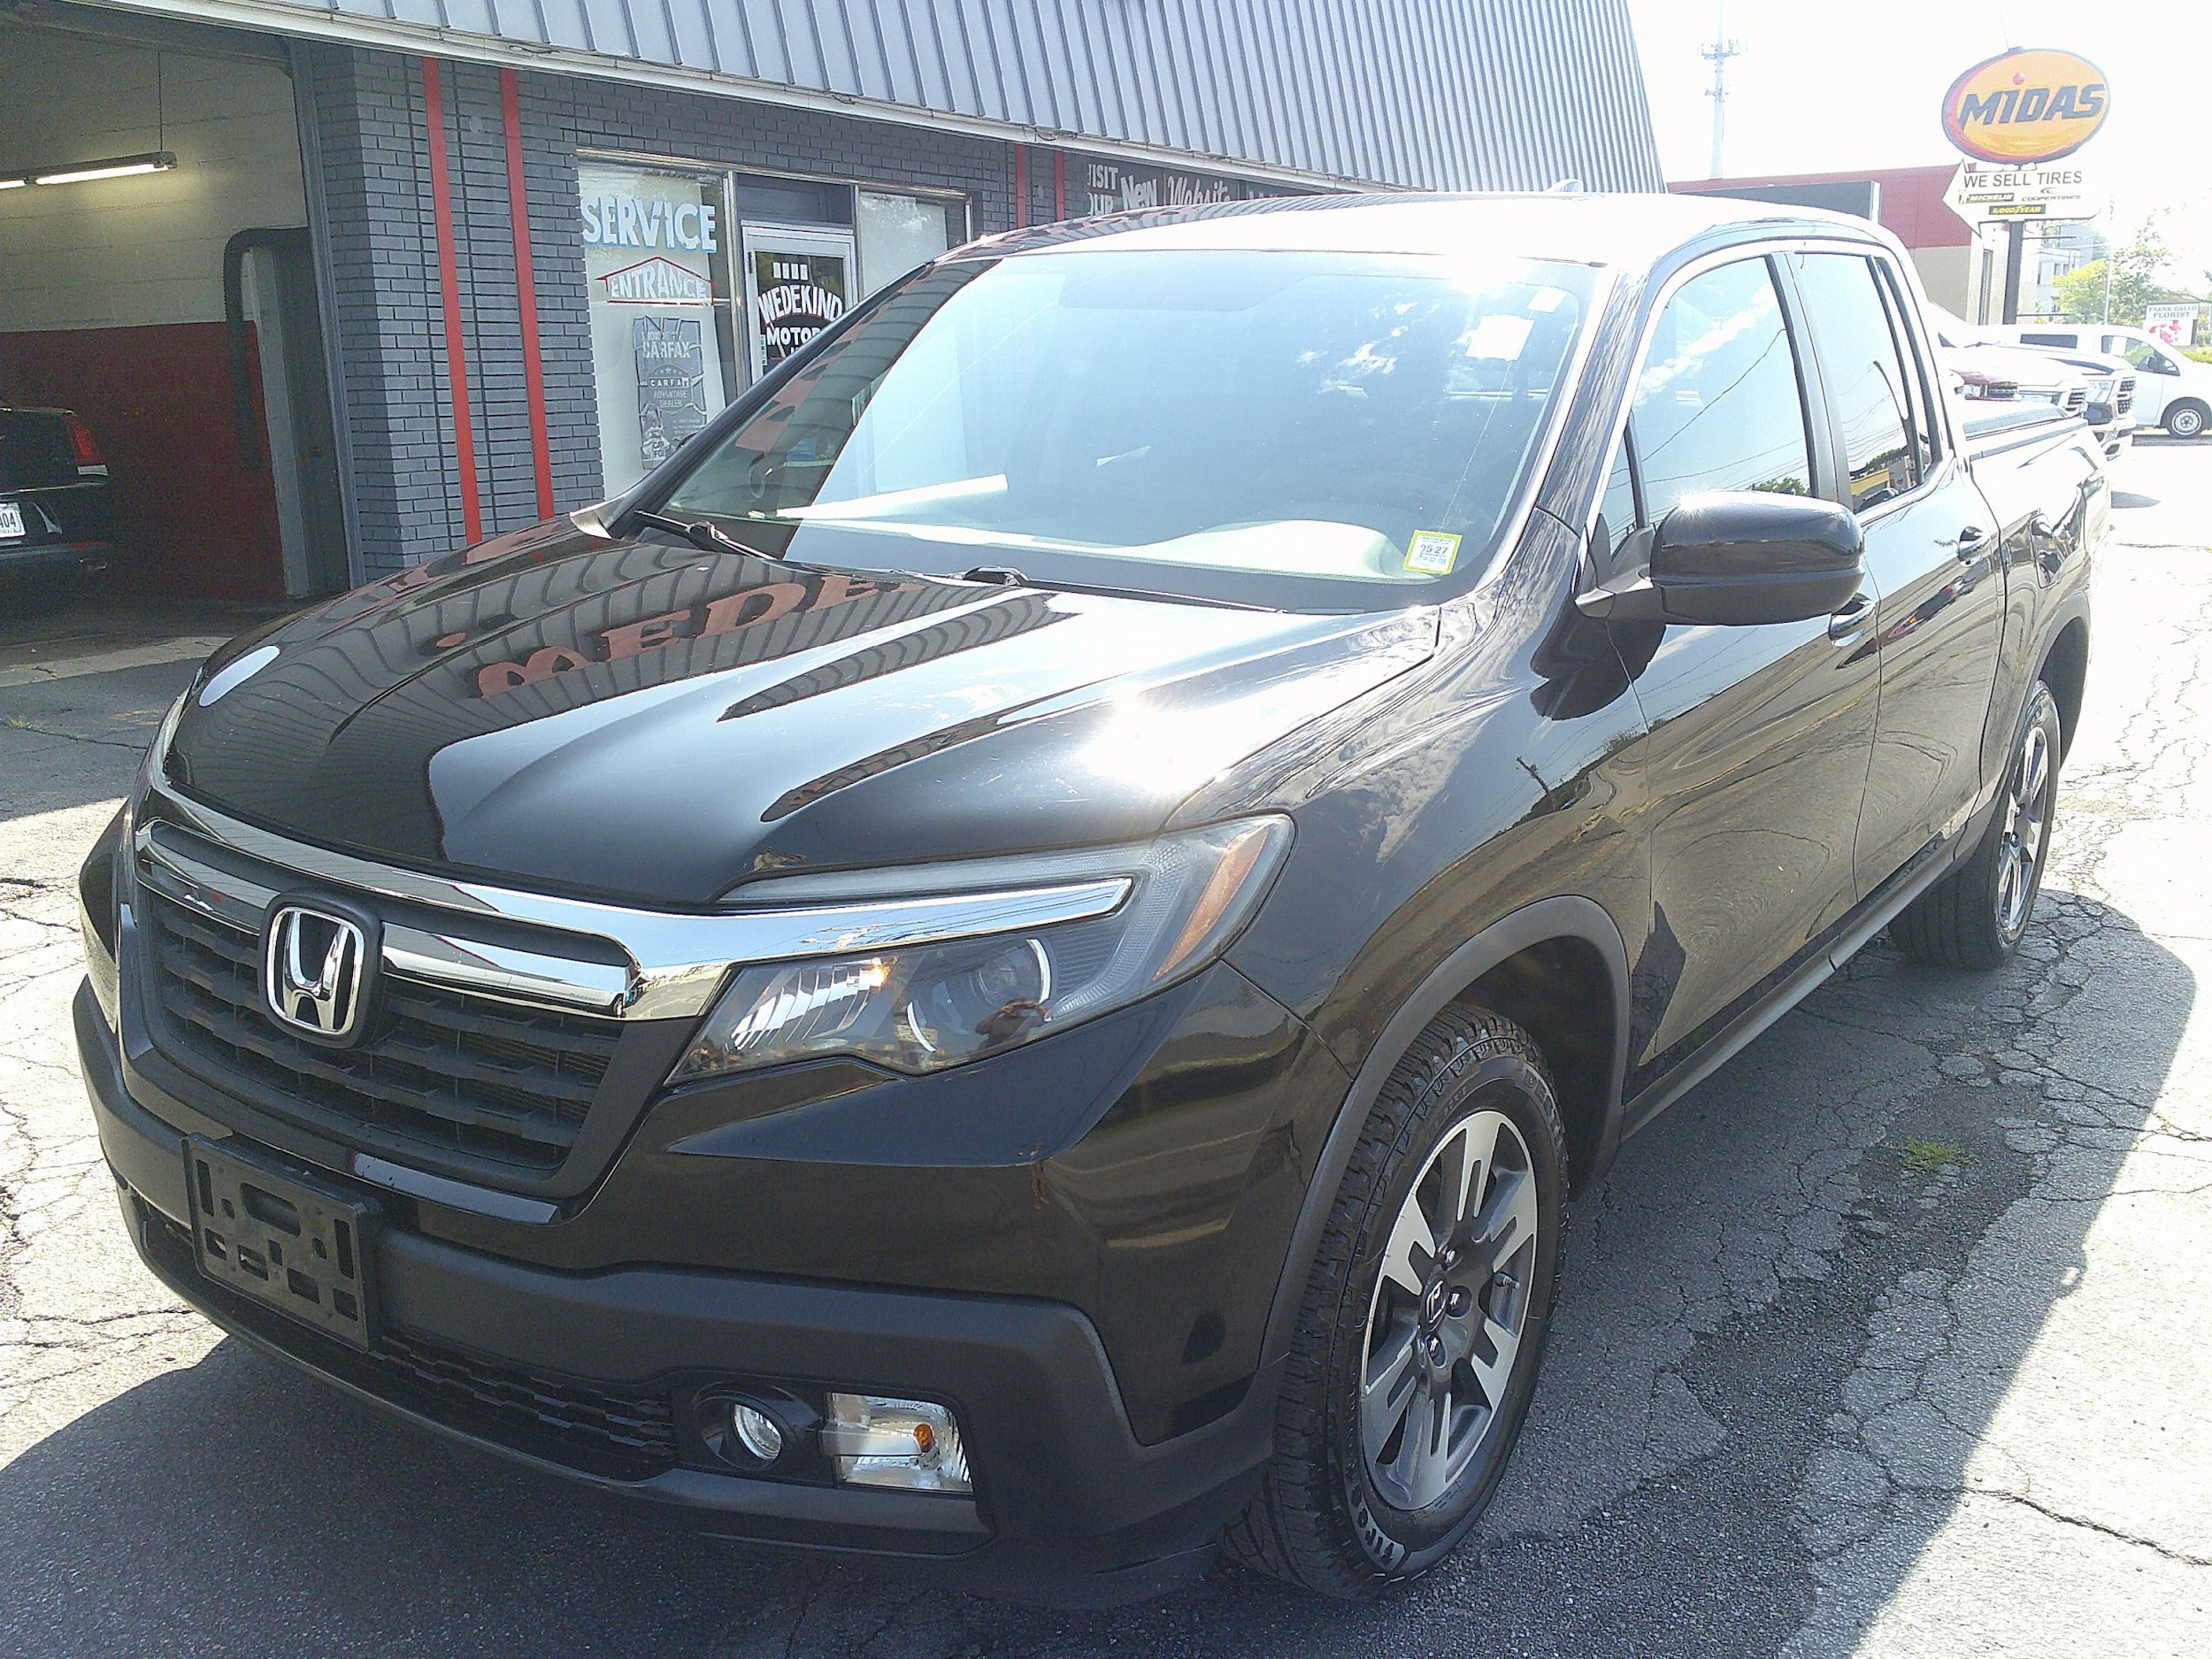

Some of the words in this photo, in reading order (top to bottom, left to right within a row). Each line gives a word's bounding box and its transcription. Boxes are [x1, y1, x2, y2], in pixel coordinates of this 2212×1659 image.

[1958, 84, 2105, 132] MIDAS
[1963, 174, 1987, 188] WE
[1993, 173, 2031, 187] SELL
[2037, 171, 2082, 185] TIRES
[580, 196, 718, 254] SERVICE
[611, 262, 707, 299] ENTRANCE
[757, 284, 843, 325] WEDEKIND
[642, 342, 691, 358] CARFAX
[649, 378, 689, 388] CARFAX
